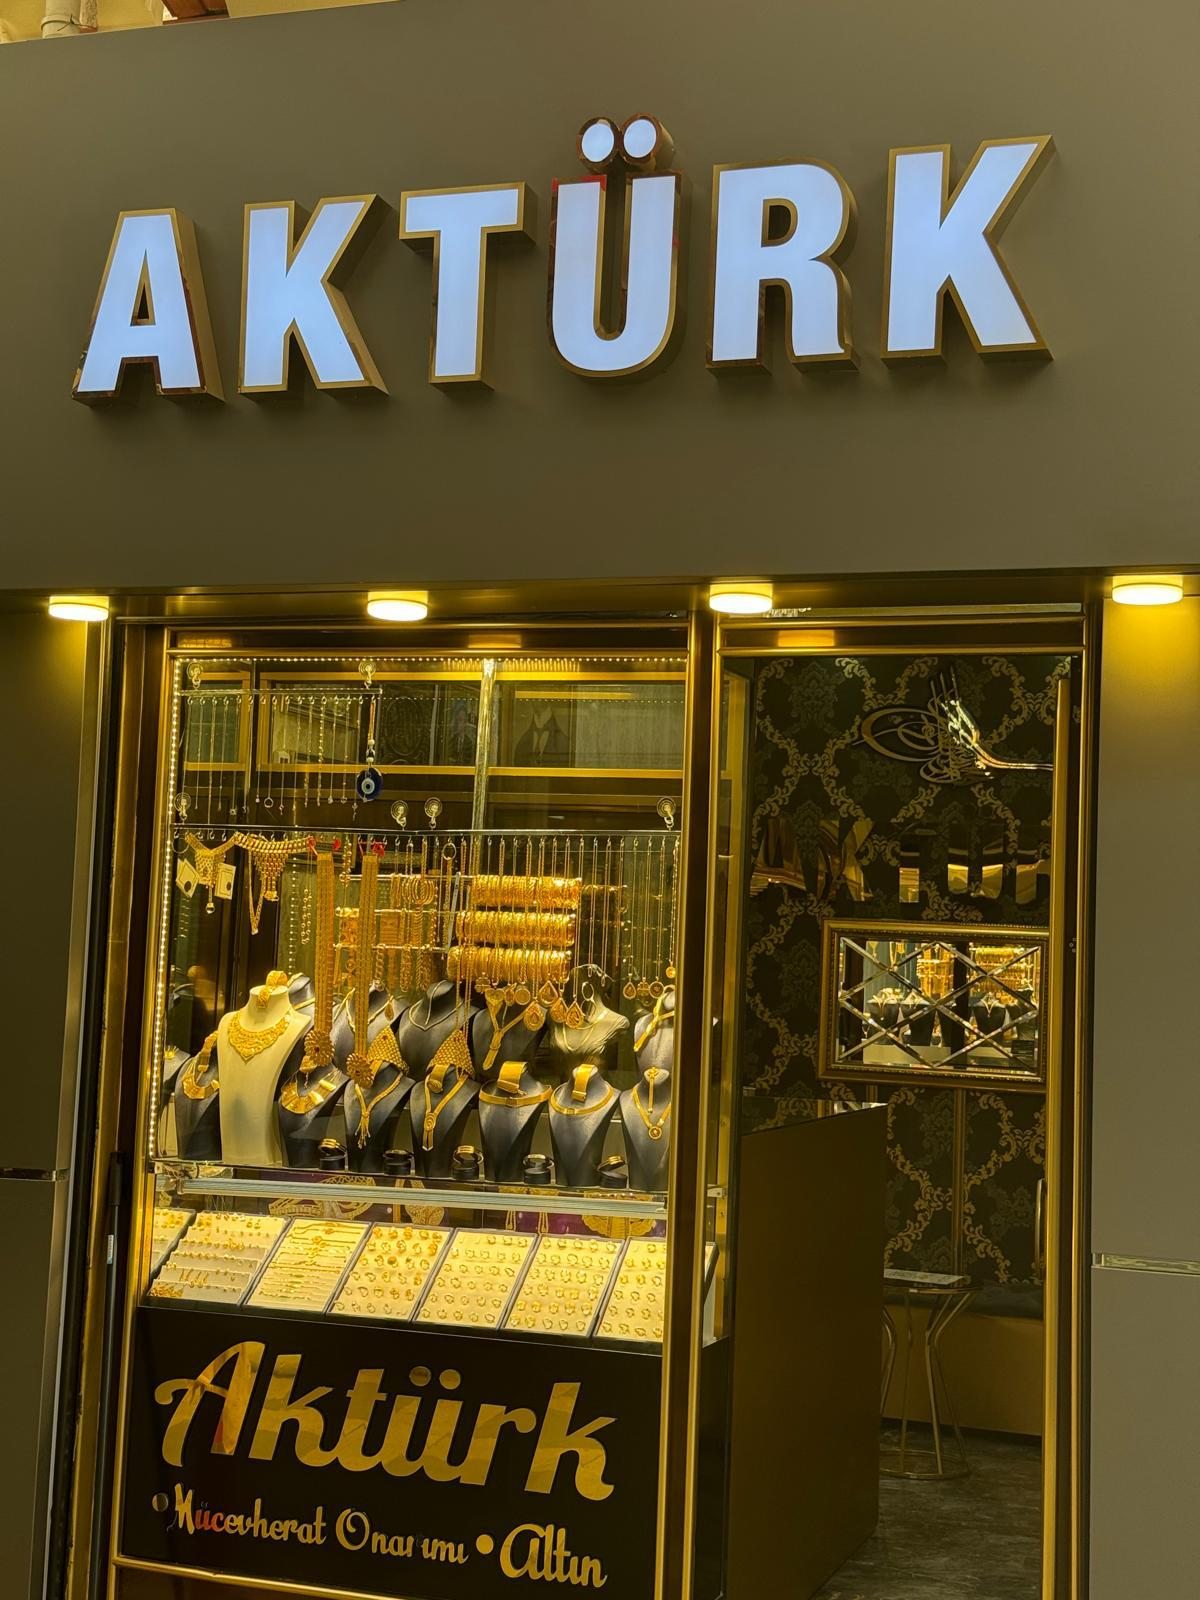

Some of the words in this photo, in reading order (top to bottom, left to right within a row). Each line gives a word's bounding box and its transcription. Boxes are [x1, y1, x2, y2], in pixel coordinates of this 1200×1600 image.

[73, 113, 1053, 405] AKTÜRK
[154, 1341, 618, 1501] Aktürk
[167, 1483, 328, 1545] Mücevherat
[500, 1523, 608, 1588] Altın
